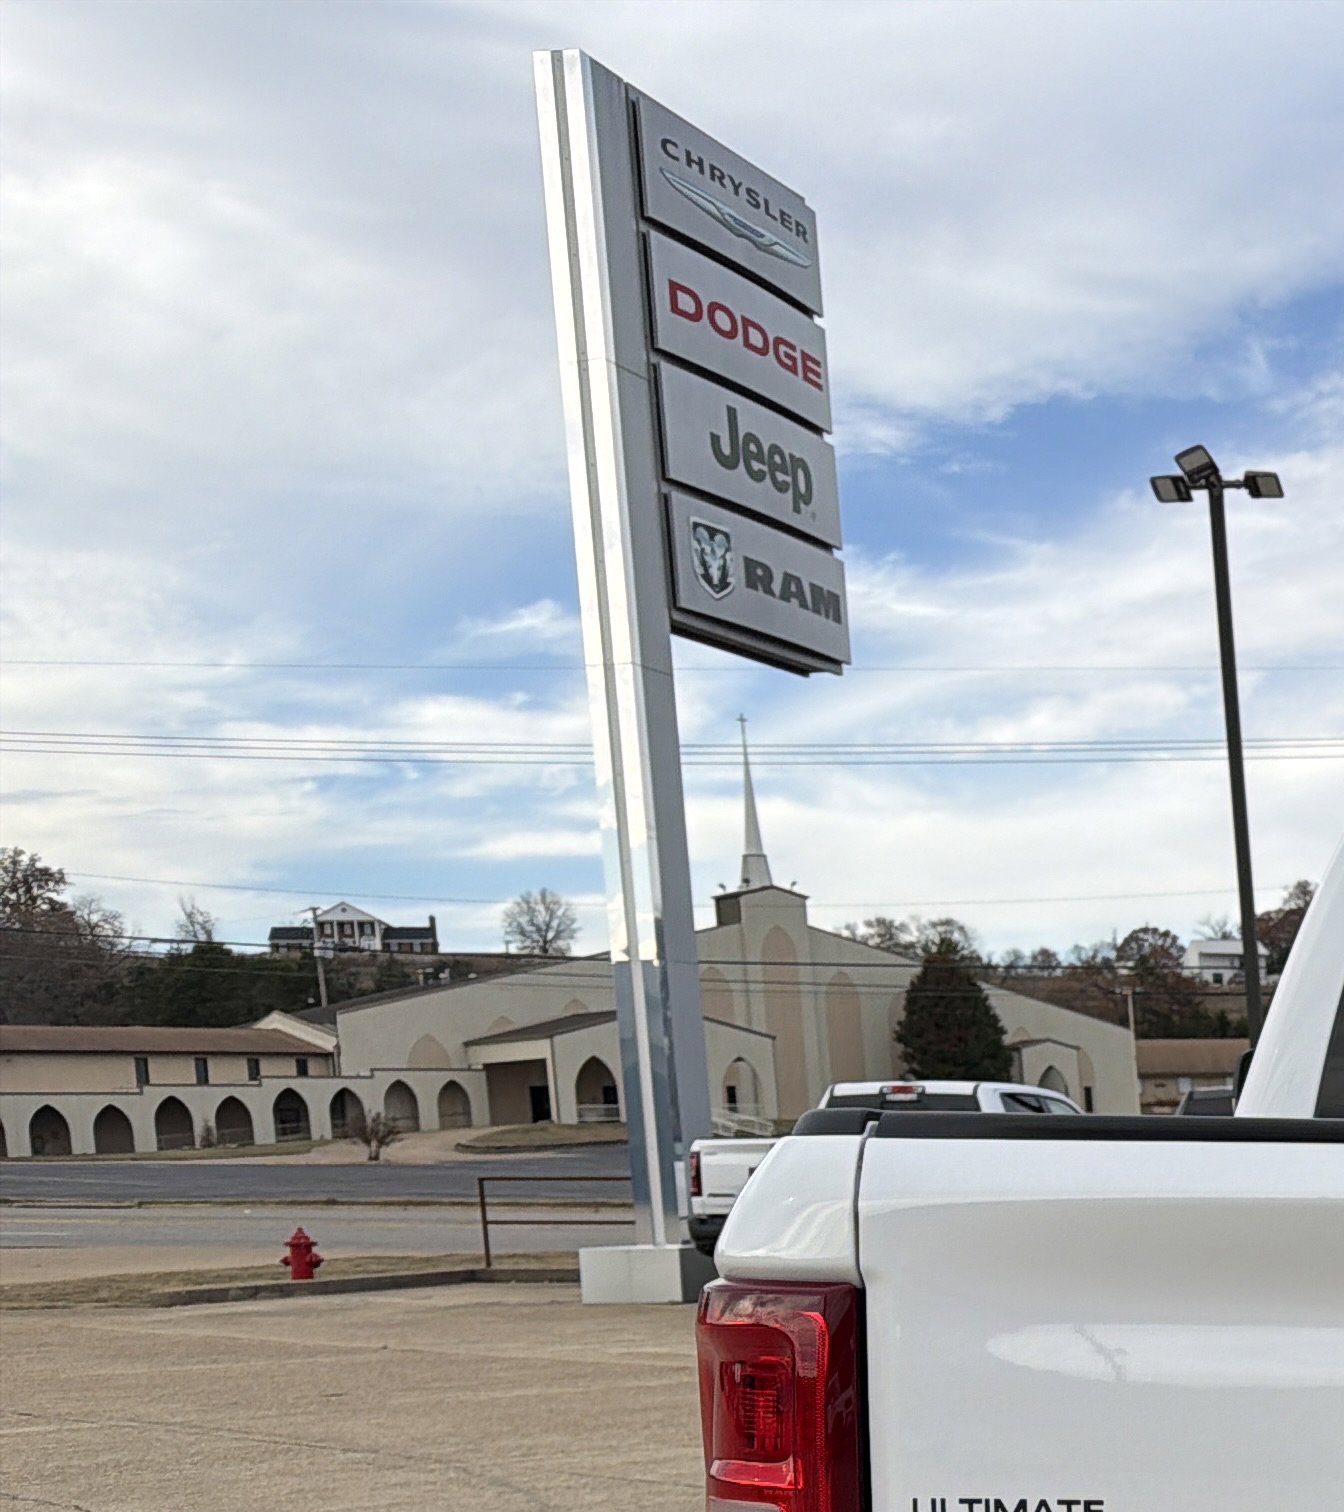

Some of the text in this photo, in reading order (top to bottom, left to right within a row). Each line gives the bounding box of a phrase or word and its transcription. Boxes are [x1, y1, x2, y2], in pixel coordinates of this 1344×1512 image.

[660, 138, 810, 243] CHRYSLER
[668, 278, 824, 392] DODGE
[709, 404, 814, 514] Jeep
[744, 556, 842, 627] RAM
